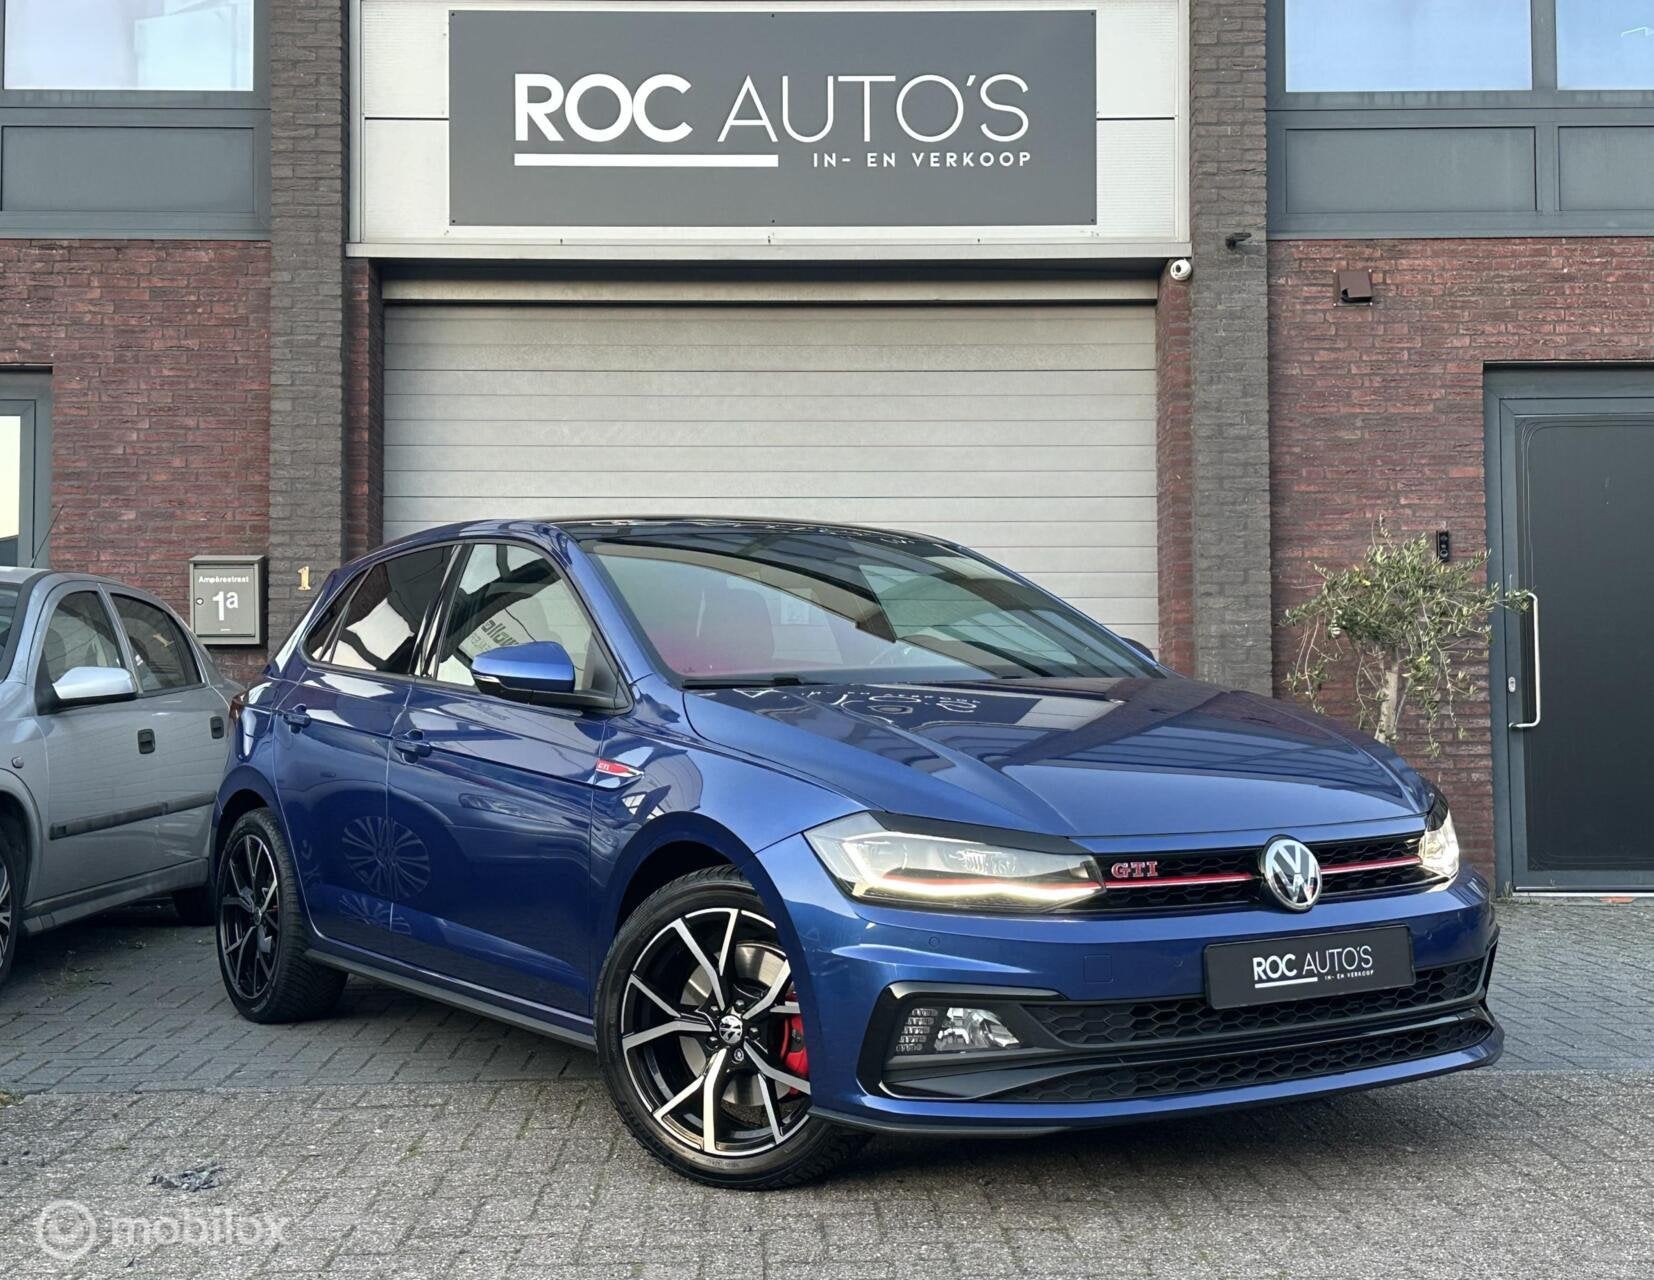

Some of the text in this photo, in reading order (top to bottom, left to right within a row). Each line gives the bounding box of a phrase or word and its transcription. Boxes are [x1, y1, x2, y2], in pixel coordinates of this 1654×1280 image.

[514, 73, 1030, 143] ROC AUTO'S
[813, 151, 1032, 168] IN- EN VERKOOP
[297, 565, 311, 590] 1
[212, 591, 239, 621] 1a
[1111, 860, 1158, 879] GTI
[1252, 945, 1373, 980] ROC AUTO'S
